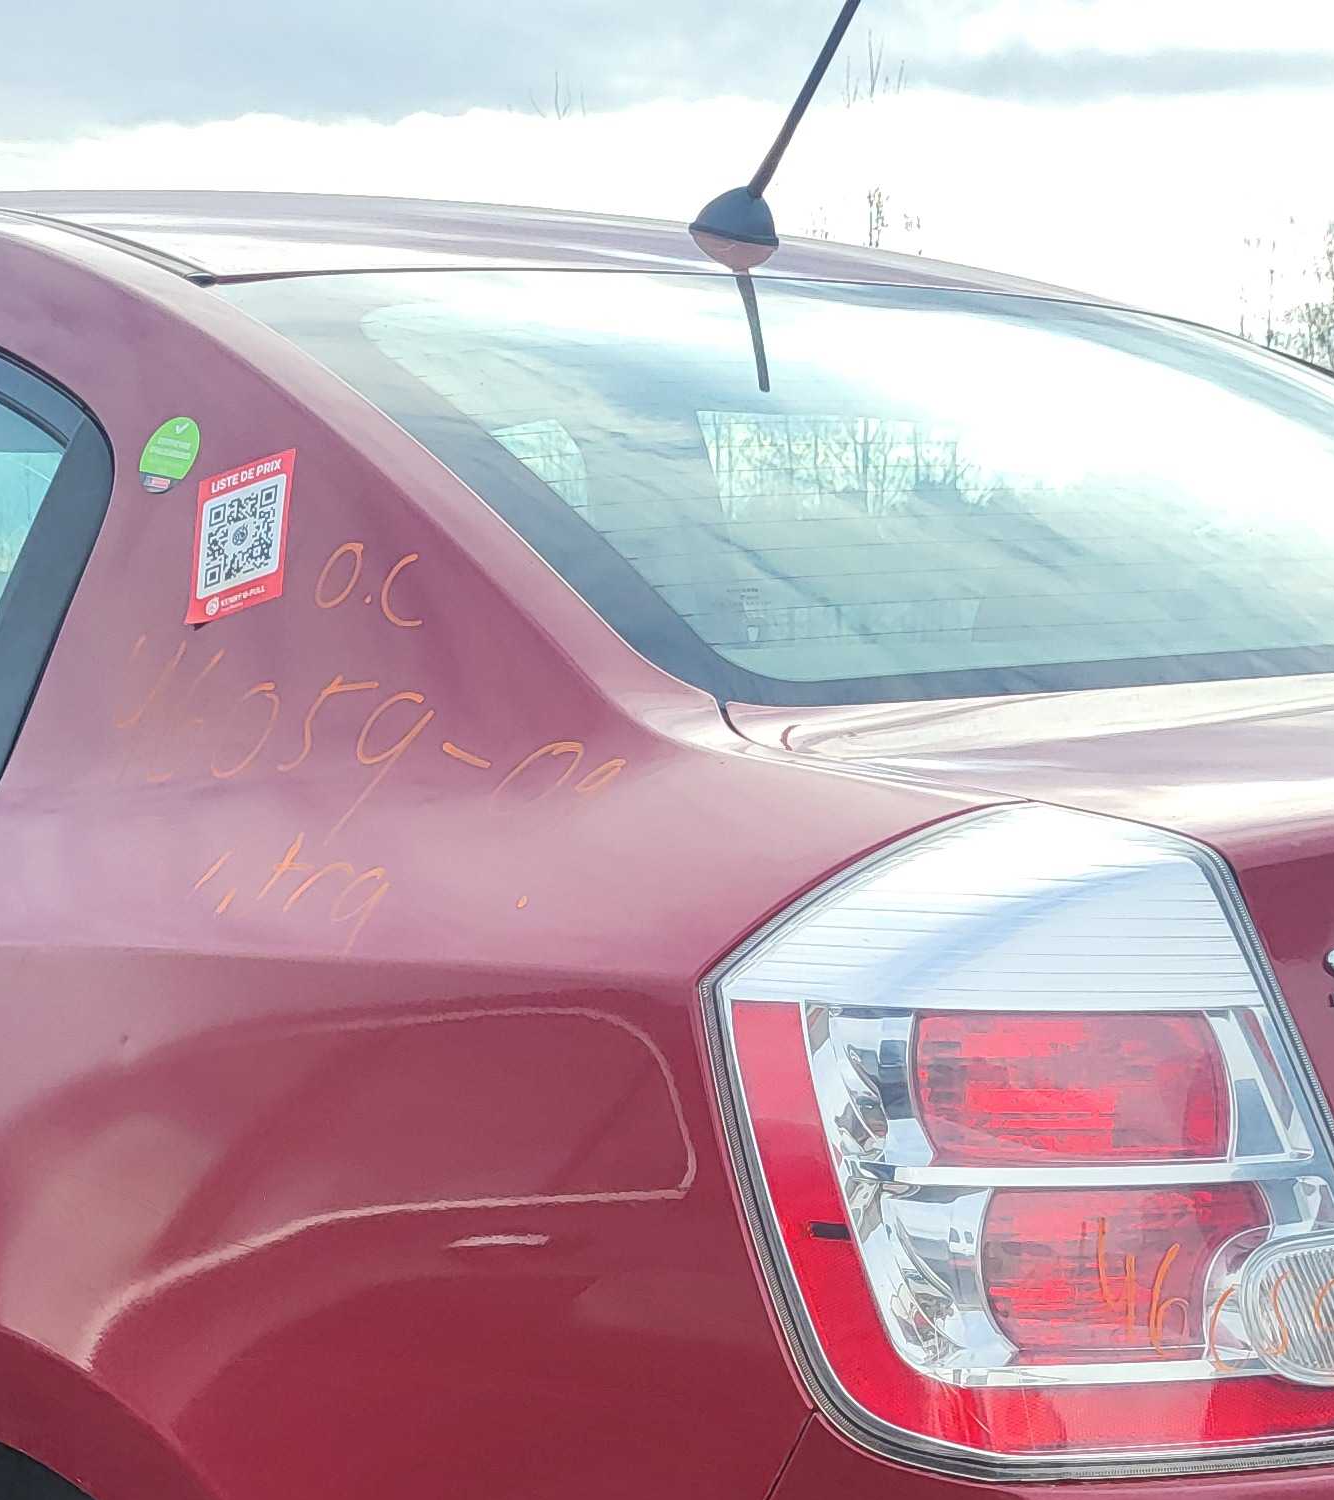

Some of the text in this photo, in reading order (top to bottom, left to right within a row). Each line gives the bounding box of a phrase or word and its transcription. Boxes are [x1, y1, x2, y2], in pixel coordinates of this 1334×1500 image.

[211, 458, 282, 493] LISTE DE PRIX
